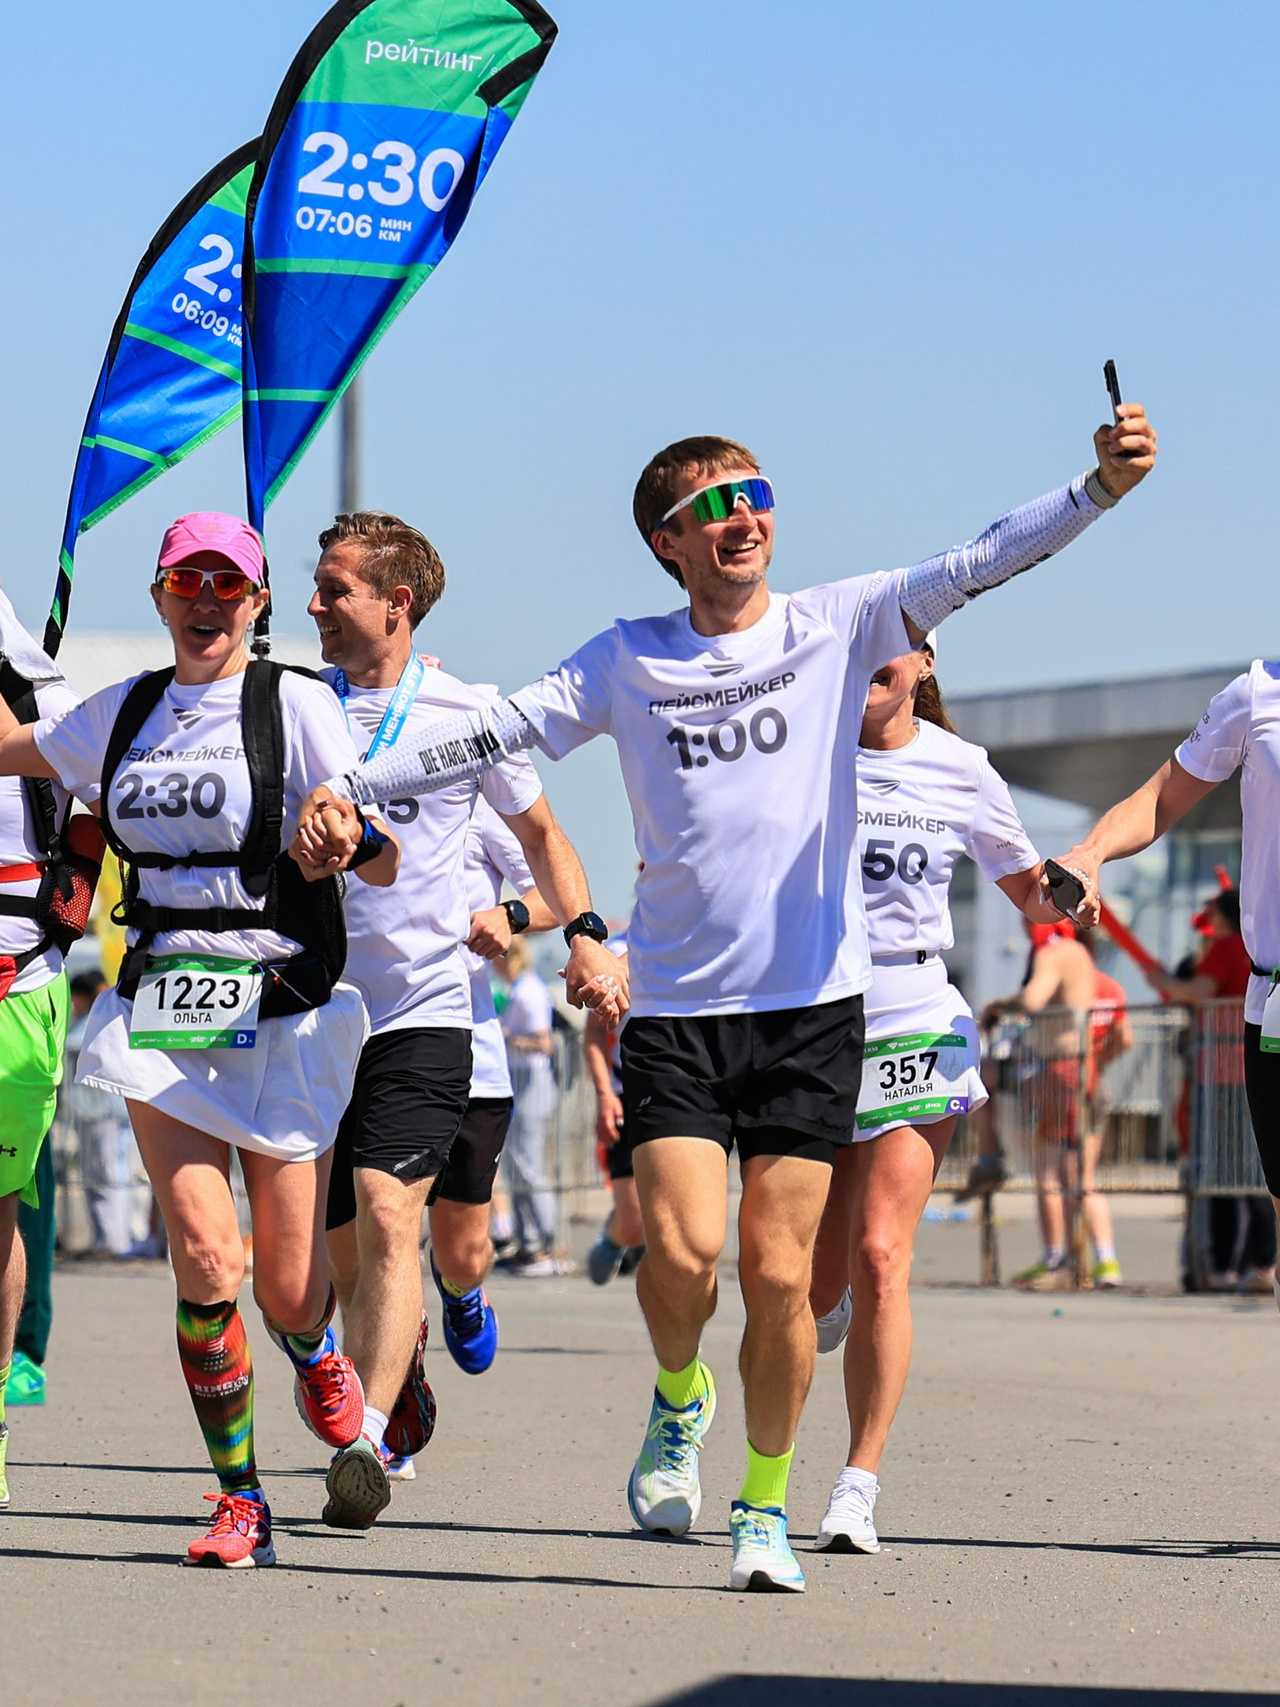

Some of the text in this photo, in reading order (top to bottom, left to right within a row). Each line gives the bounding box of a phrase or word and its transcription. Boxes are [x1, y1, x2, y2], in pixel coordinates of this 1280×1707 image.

[365, 38, 483, 72] рейтинг
[297, 131, 466, 213] 2:30
[296, 206, 373, 238] 07:06
[183, 234, 242, 312] 2:
[171, 292, 229, 337] 06:09
[648, 671, 796, 715] ПЕЙСМЕЙКЕР
[123, 745, 247, 763] ЕЙСМЕЙКЕР
[666, 707, 787, 770] 1:00
[418, 748, 441, 775] DIE
[435, 740, 468, 770] HARD
[116, 772, 226, 820] 2:30
[154, 976, 241, 1010] 1223
[173, 1012, 213, 1024] ОЛЬГА
[879, 1051, 938, 1090] 357
[884, 1083, 933, 1101] НАТАЛЬЯ
